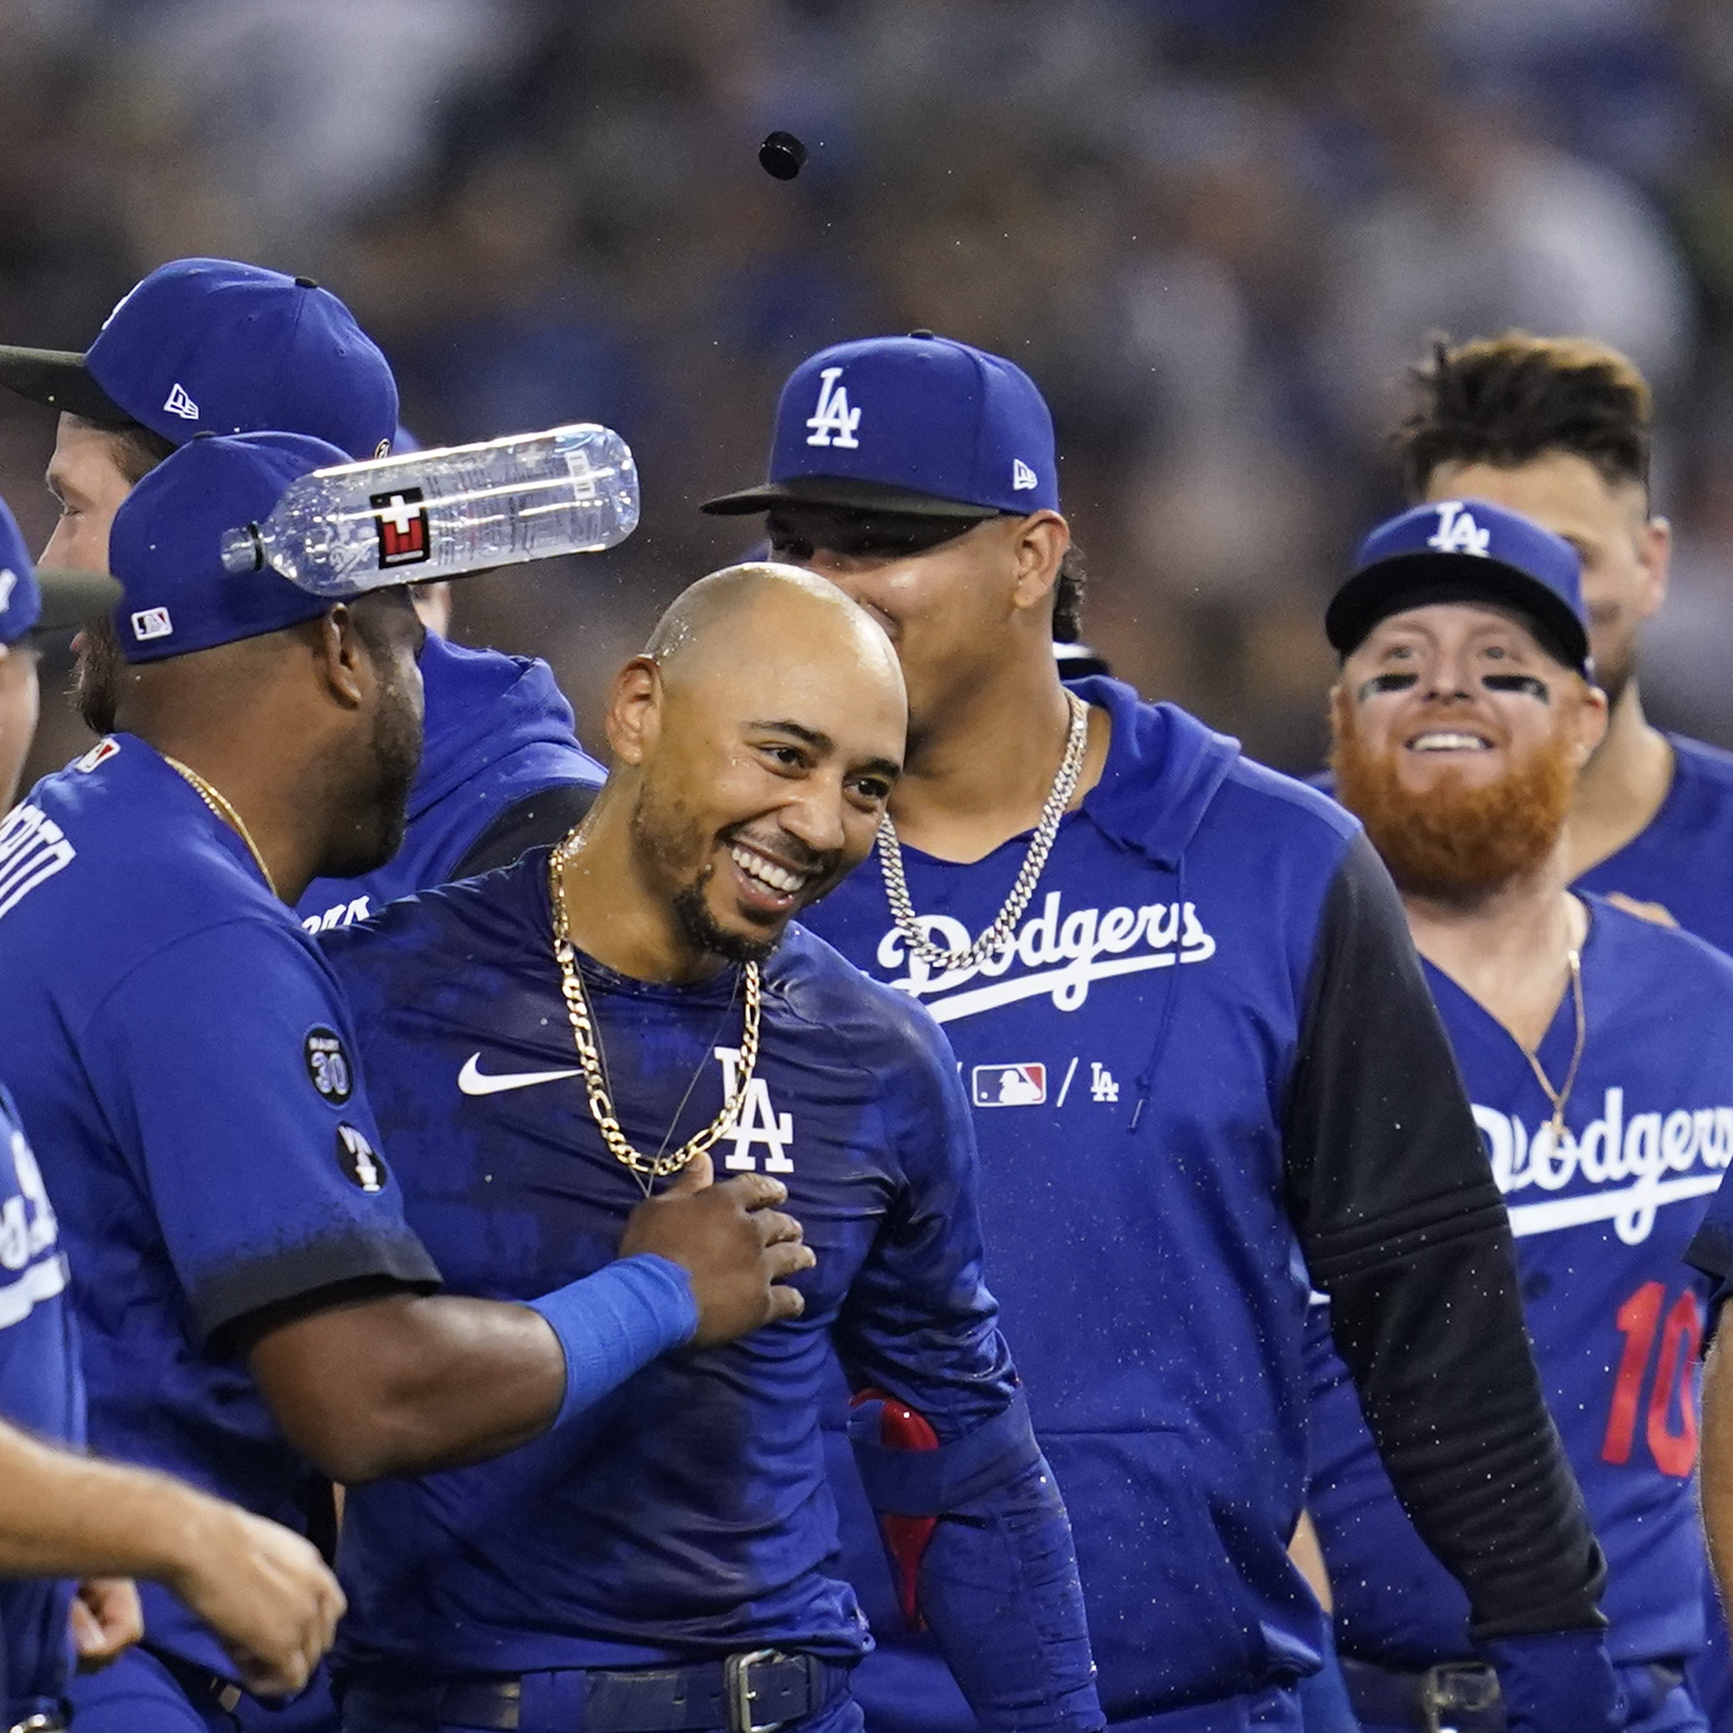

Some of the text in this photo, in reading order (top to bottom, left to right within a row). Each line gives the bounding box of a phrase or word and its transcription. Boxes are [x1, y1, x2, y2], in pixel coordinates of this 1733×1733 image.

[807, 367, 862, 449] LA
[1427, 501, 1490, 558] LA
[876, 891, 1217, 1012] Dodgers
[311, 1052, 350, 1096] 30
[714, 1047, 794, 1173] LA
[1090, 1062, 1119, 1102] LA
[1601, 1280, 1703, 1478] 10
